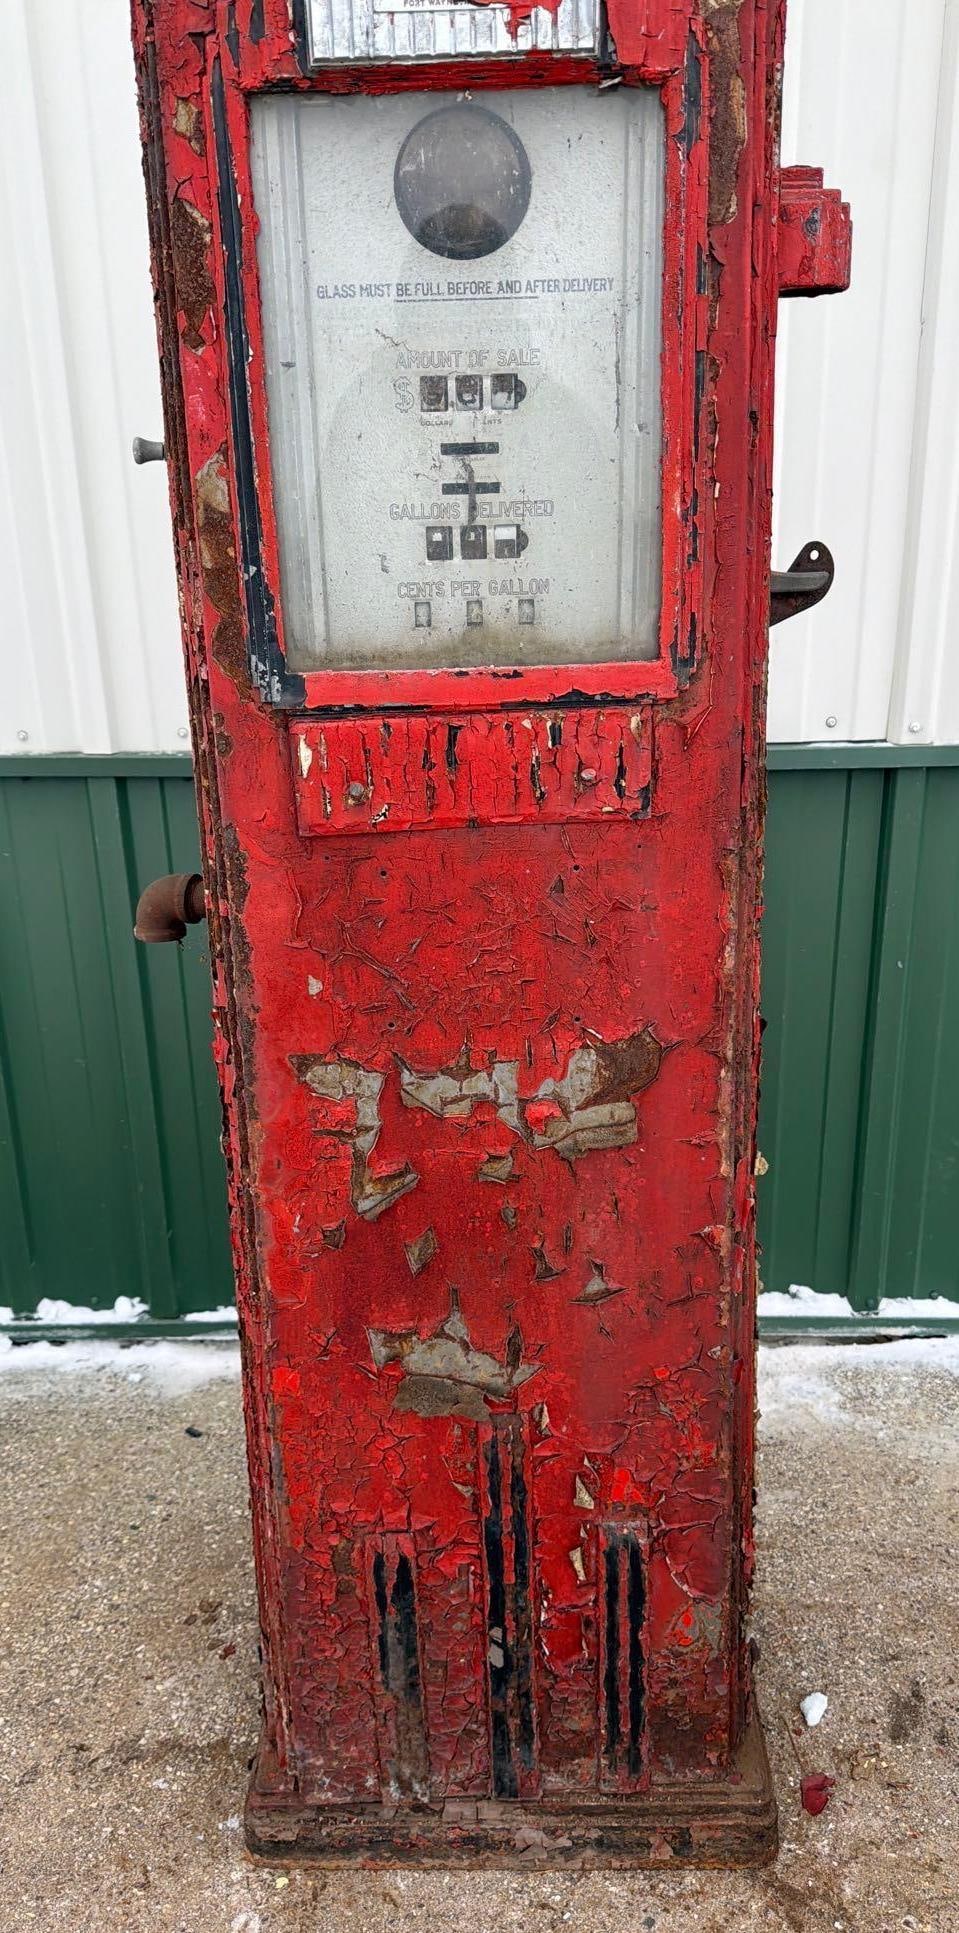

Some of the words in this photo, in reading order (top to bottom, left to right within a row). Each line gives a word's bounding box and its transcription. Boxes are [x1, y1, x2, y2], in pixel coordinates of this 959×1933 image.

[316, 284, 356, 299] GLASS
[359, 283, 391, 297] MUST
[396, 283, 412, 297] BE
[414, 282, 443, 296] FULL
[448, 280, 492, 295] BEFORE
[497, 280, 522, 294] AND
[525, 278, 560, 293] AFTER
[563, 277, 614, 293] DELIVERY
[396, 350, 462, 369] AMOUNT
[466, 350, 489, 368] OF
[496, 348, 541, 366] SALE
[389, 502, 461, 520] GALLONS
[397, 580, 445, 599] CENTS
[450, 580, 483, 597] PER
[487, 578, 550, 597] GALLON
